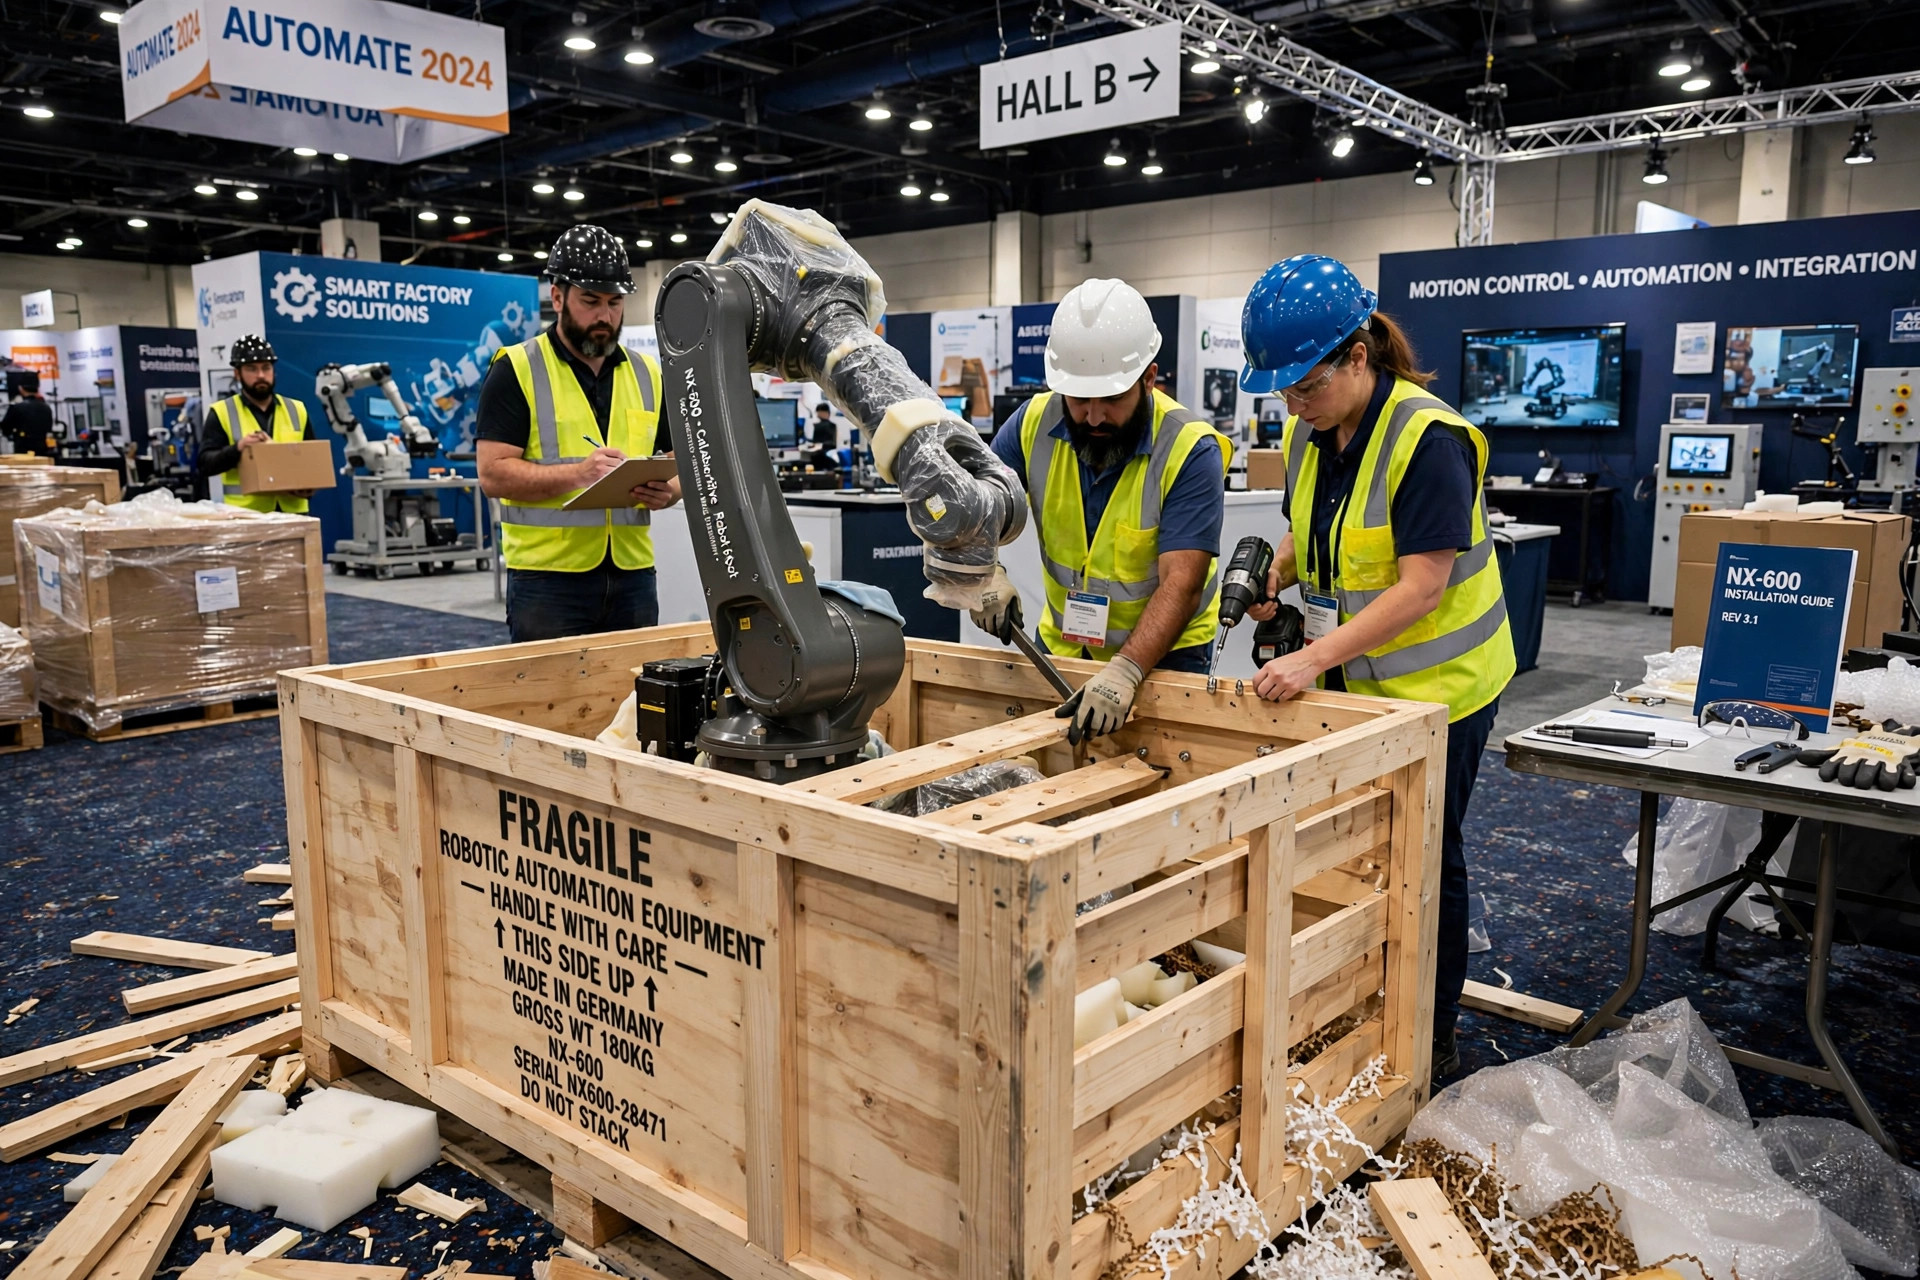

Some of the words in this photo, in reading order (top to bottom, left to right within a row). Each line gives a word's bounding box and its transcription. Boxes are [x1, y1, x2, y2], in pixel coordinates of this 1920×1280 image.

[127, 25, 175, 81] AUTOMATE
[177, 9, 201, 51] 2024
[222, 6, 413, 76] AUTOMATE
[421, 48, 494, 91] 2024
[997, 71, 1082, 123] HALL
[1095, 63, 1117, 105] B
[325, 276, 391, 299] SMART
[395, 282, 473, 306] FACTORY
[1409, 277, 1480, 299] MOTION
[1484, 272, 1574, 295] CONTROL
[1592, 261, 1732, 288] AUTOMATION
[1755, 249, 1917, 279] INTEGRATION
[325, 301, 430, 324] SOLUTIONS
[1724, 588, 1798, 604] INSTALLATION
[1800, 595, 1835, 608] GUIDE
[1726, 566, 1802, 591] NX-600
[1721, 611, 1742, 623] REV
[1743, 614, 1758, 625] 3.1
[498, 789, 653, 888] FRAGILE
[440, 828, 509, 878] ROBOTIC
[515, 856, 634, 923] AUTOMATION
[642, 898, 766, 970] EQUIPMENT
[490, 881, 556, 932] HANDLE
[561, 907, 608, 951] WITH
[615, 928, 668, 975] CARE
[511, 924, 551, 965] THIS
[558, 944, 601, 987] SIDE
[608, 962, 635, 998] UP
[503, 955, 548, 999] MADE
[553, 977, 571, 1008] IN
[576, 987, 664, 1048] GERMANY
[512, 990, 564, 1035] GROSS
[568, 1015, 594, 1048] WT
[600, 1030, 655, 1078] 180KG
[513, 1045, 563, 1089] SERIAL
[567, 1070, 667, 1142] NX600-28471
[548, 1035, 604, 1081] NX-600
[520, 1074, 541, 1103] DO
[545, 1085, 574, 1121] NOT
[579, 1104, 630, 1152] STACK
